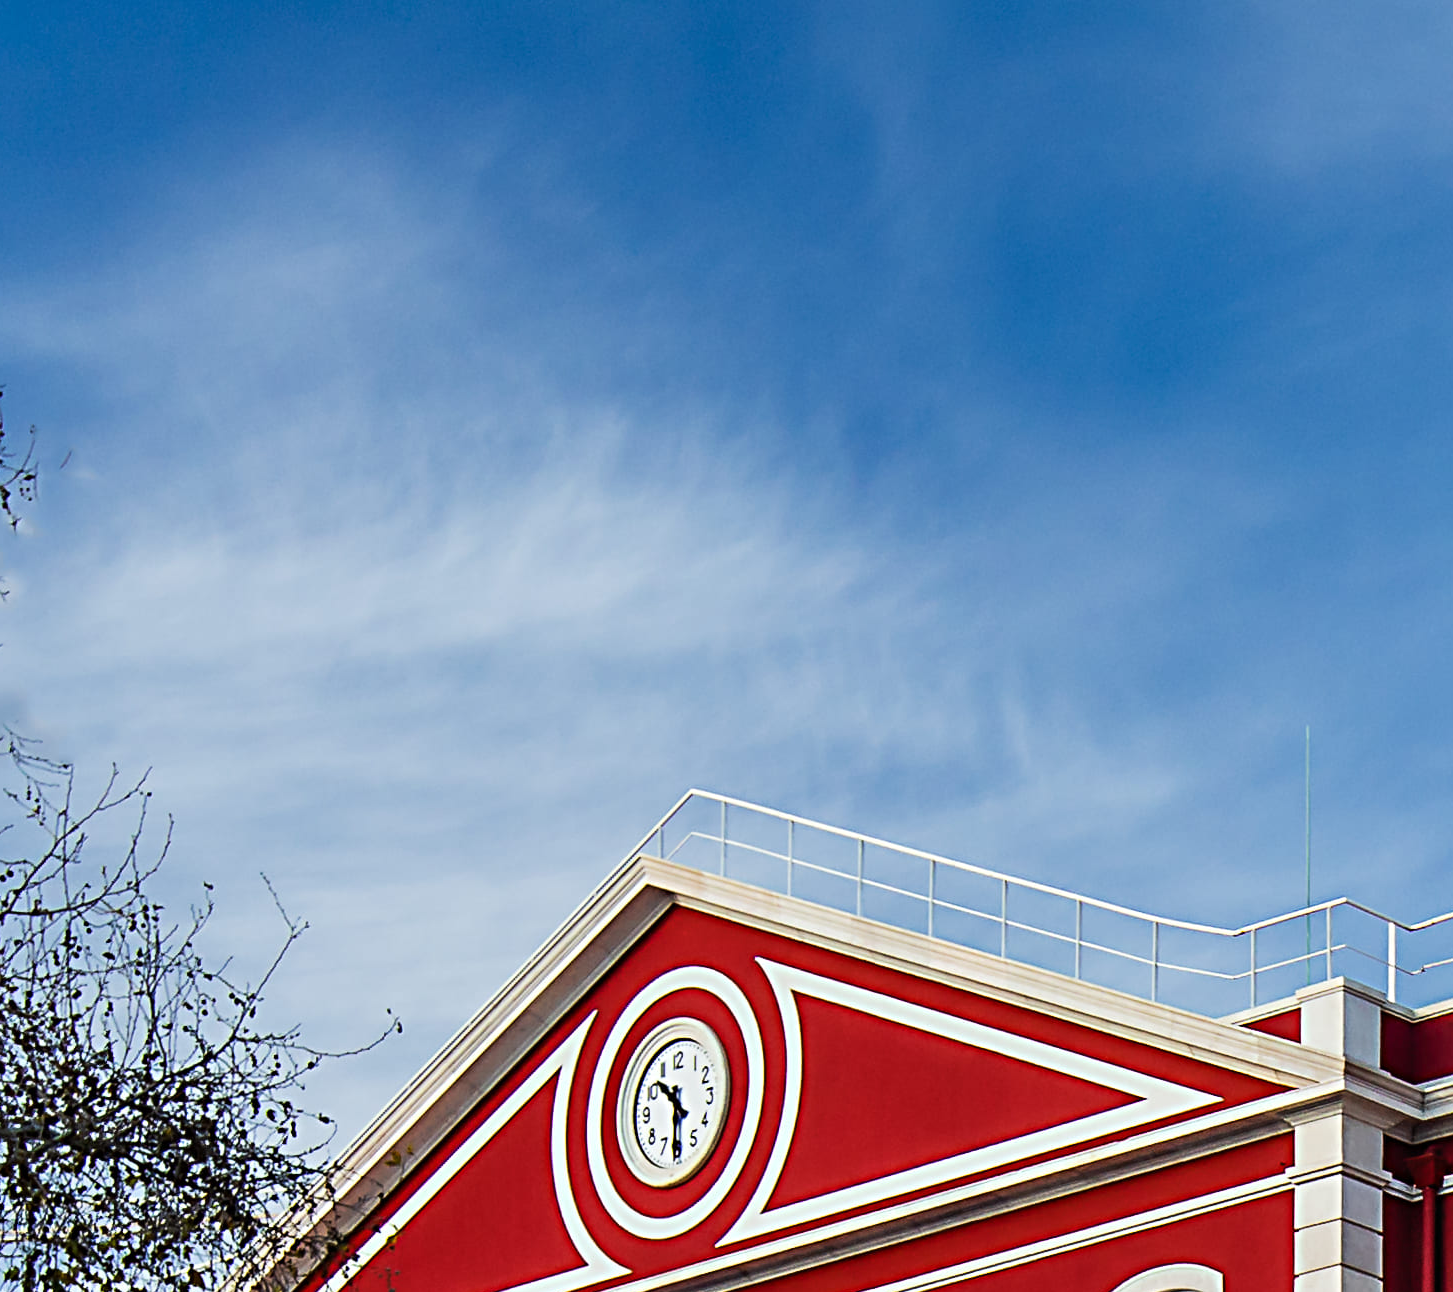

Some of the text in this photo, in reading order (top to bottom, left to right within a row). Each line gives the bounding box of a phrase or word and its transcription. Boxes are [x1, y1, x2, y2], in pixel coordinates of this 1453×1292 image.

[673, 1051, 684, 1070] 12
[701, 1066, 709, 1084] 2
[706, 1086, 714, 1105] 3
[642, 1106, 650, 1124] 9
[701, 1112, 709, 1128] 4
[648, 1128, 656, 1145] 8
[689, 1129, 698, 1147] 5
[660, 1137, 668, 1156] 7
